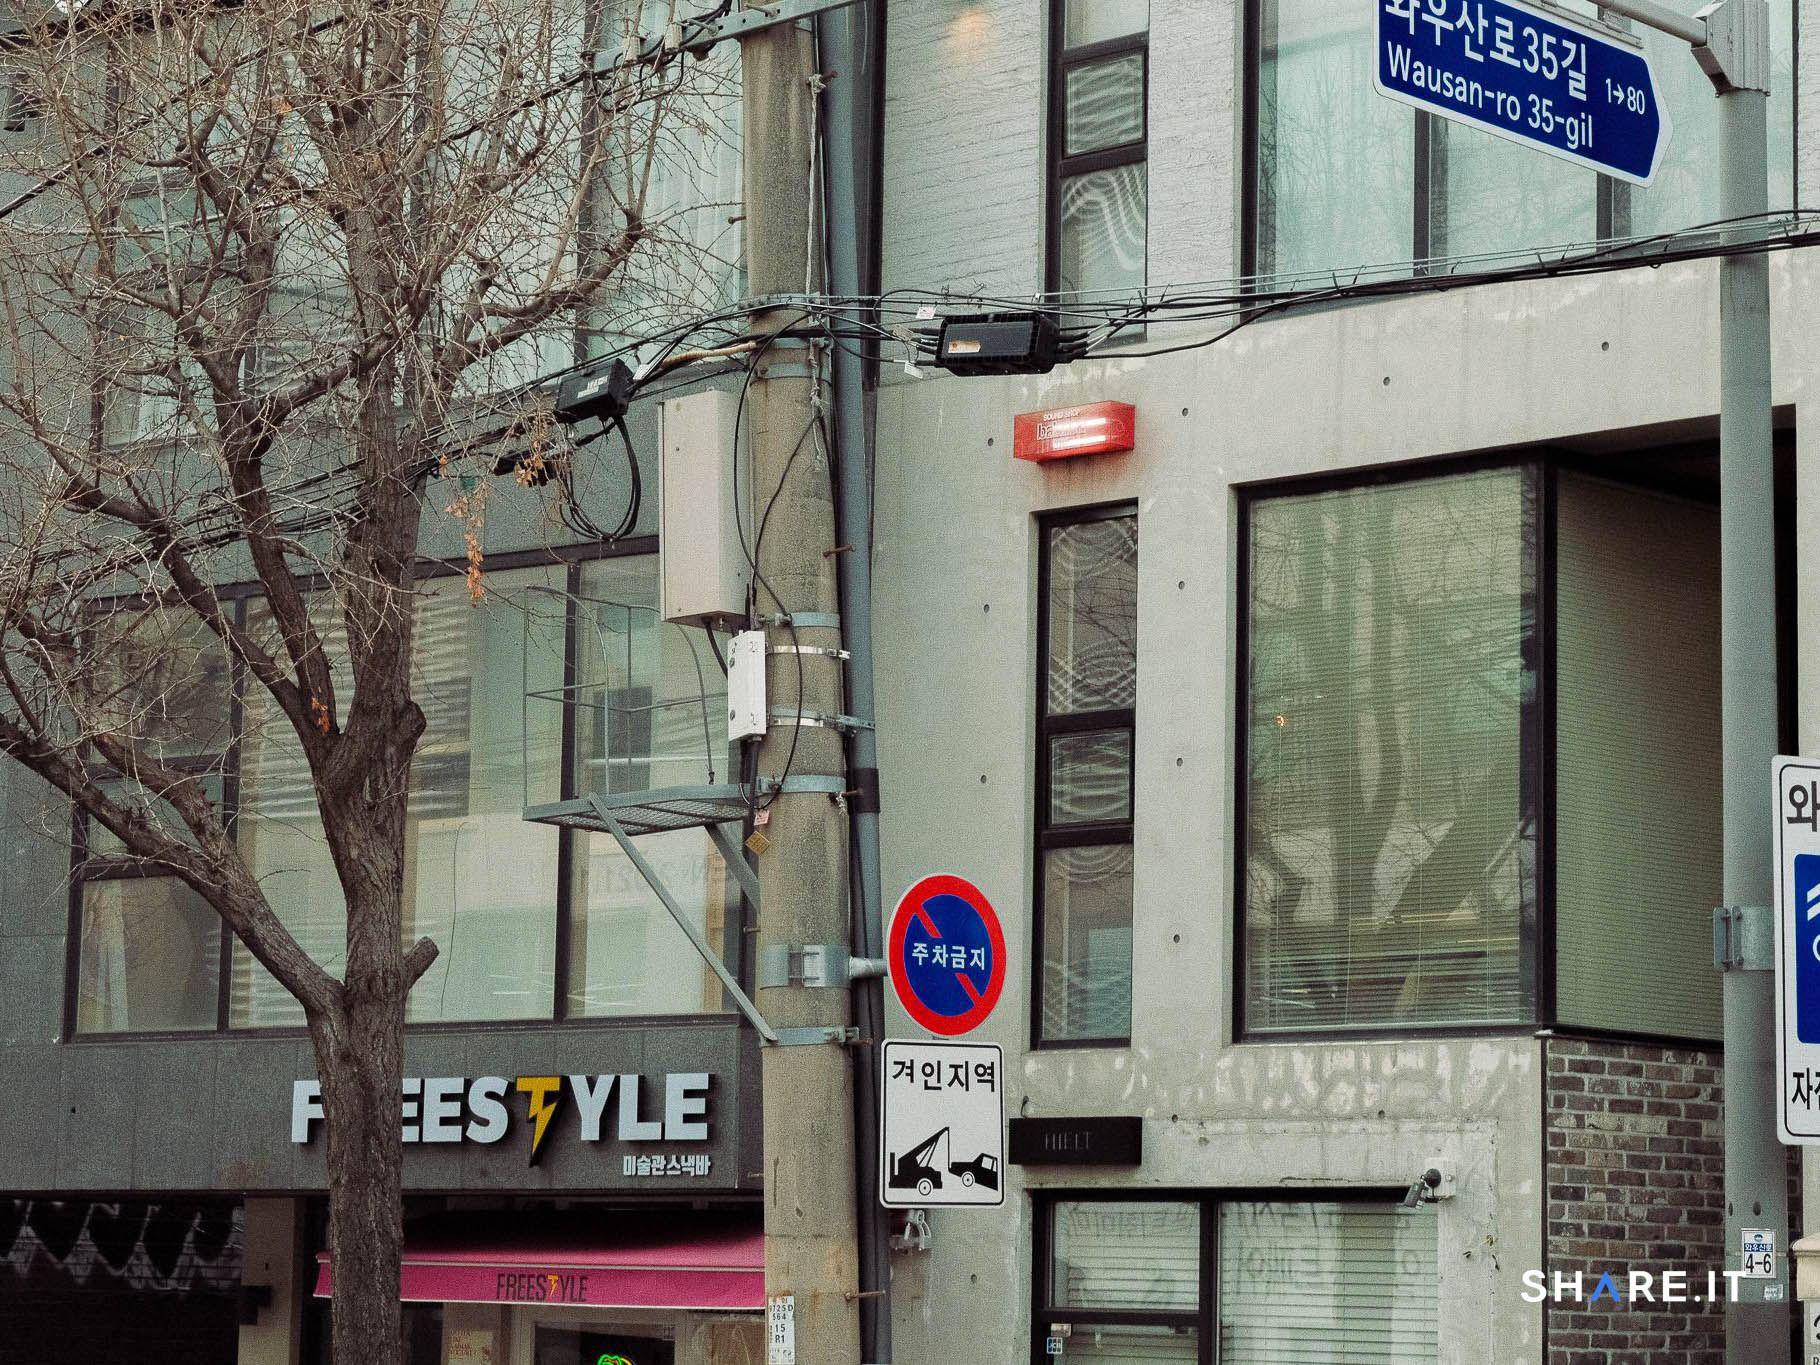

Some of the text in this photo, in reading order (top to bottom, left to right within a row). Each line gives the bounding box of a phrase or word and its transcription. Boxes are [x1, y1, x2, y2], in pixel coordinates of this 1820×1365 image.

[1387, 41, 1593, 149] Wausan-ro 35-gil
[912, 942, 985, 970] 주차금지
[291, 1073, 710, 1154] FESTYLE
[623, 1155, 711, 1176] 미술관스낵바
[1745, 1253, 1772, 1274] 4-6
[496, 1274, 588, 1302] FREESTYLE
